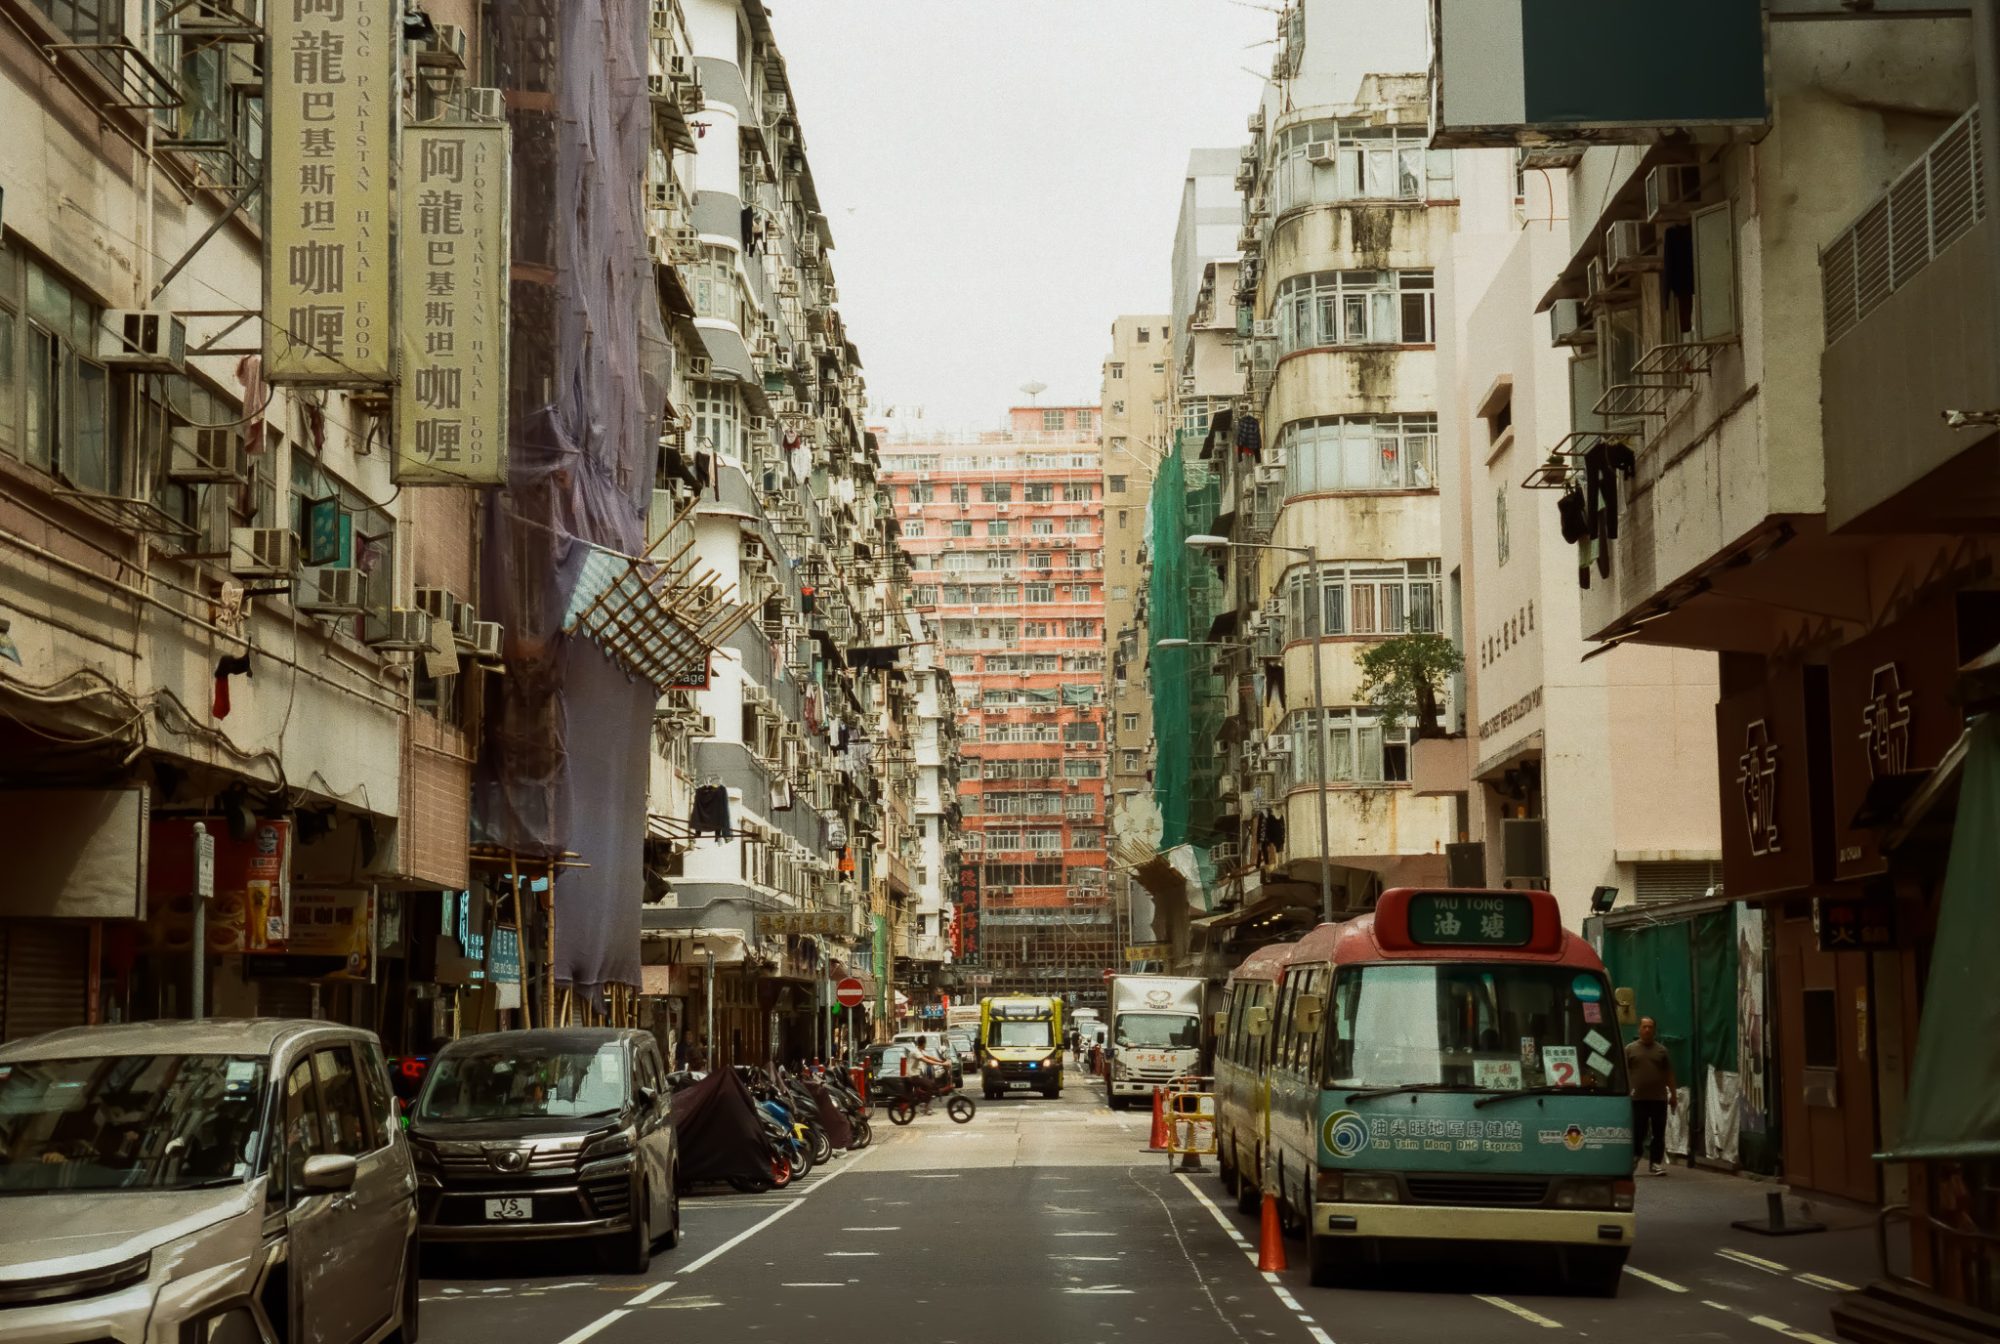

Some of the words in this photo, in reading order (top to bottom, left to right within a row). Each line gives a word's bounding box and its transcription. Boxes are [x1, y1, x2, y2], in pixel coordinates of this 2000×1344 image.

[356, 75, 371, 192] PAKISTAN
[473, 141, 486, 214] AHLONG
[356, 209, 370, 284] HALAL
[472, 228, 485, 325] PAKISTAN
[356, 301, 371, 359] FOOD
[471, 340, 484, 402] HALAL
[471, 416, 484, 464] FOOD
[1434, 897, 1459, 910] YAU
[1466, 899, 1504, 911] TONG
[1434, 911, 1505, 938] 油塘
[1371, 1138, 1390, 1149] Yau
[1394, 1139, 1419, 1150] Tsim
[1424, 1139, 1452, 1152] Mong
[1483, 1140, 1522, 1152] Express
